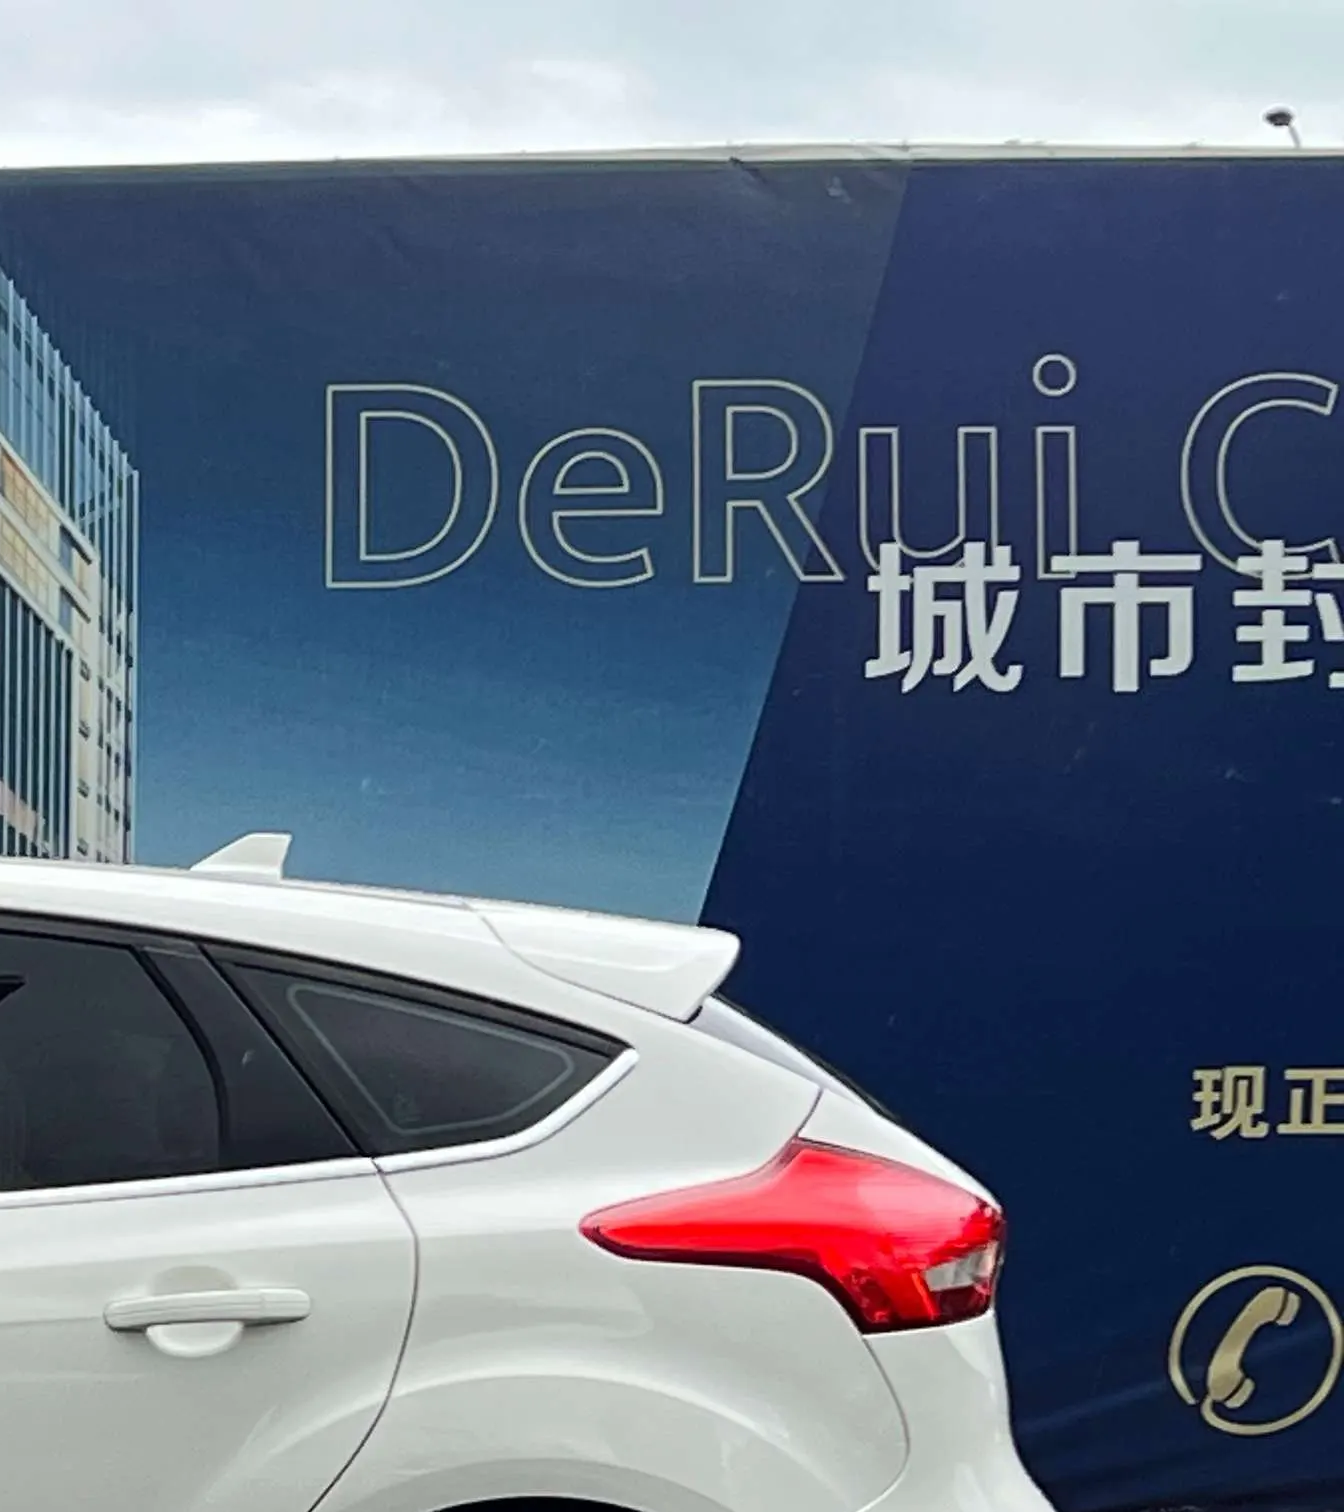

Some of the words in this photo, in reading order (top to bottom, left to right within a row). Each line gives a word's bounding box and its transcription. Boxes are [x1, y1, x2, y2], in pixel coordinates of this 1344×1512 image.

[326, 353, 1079, 589] DeRui
[864, 539, 1344, 693] 城市封
[1190, 1065, 1344, 1140] 现正
